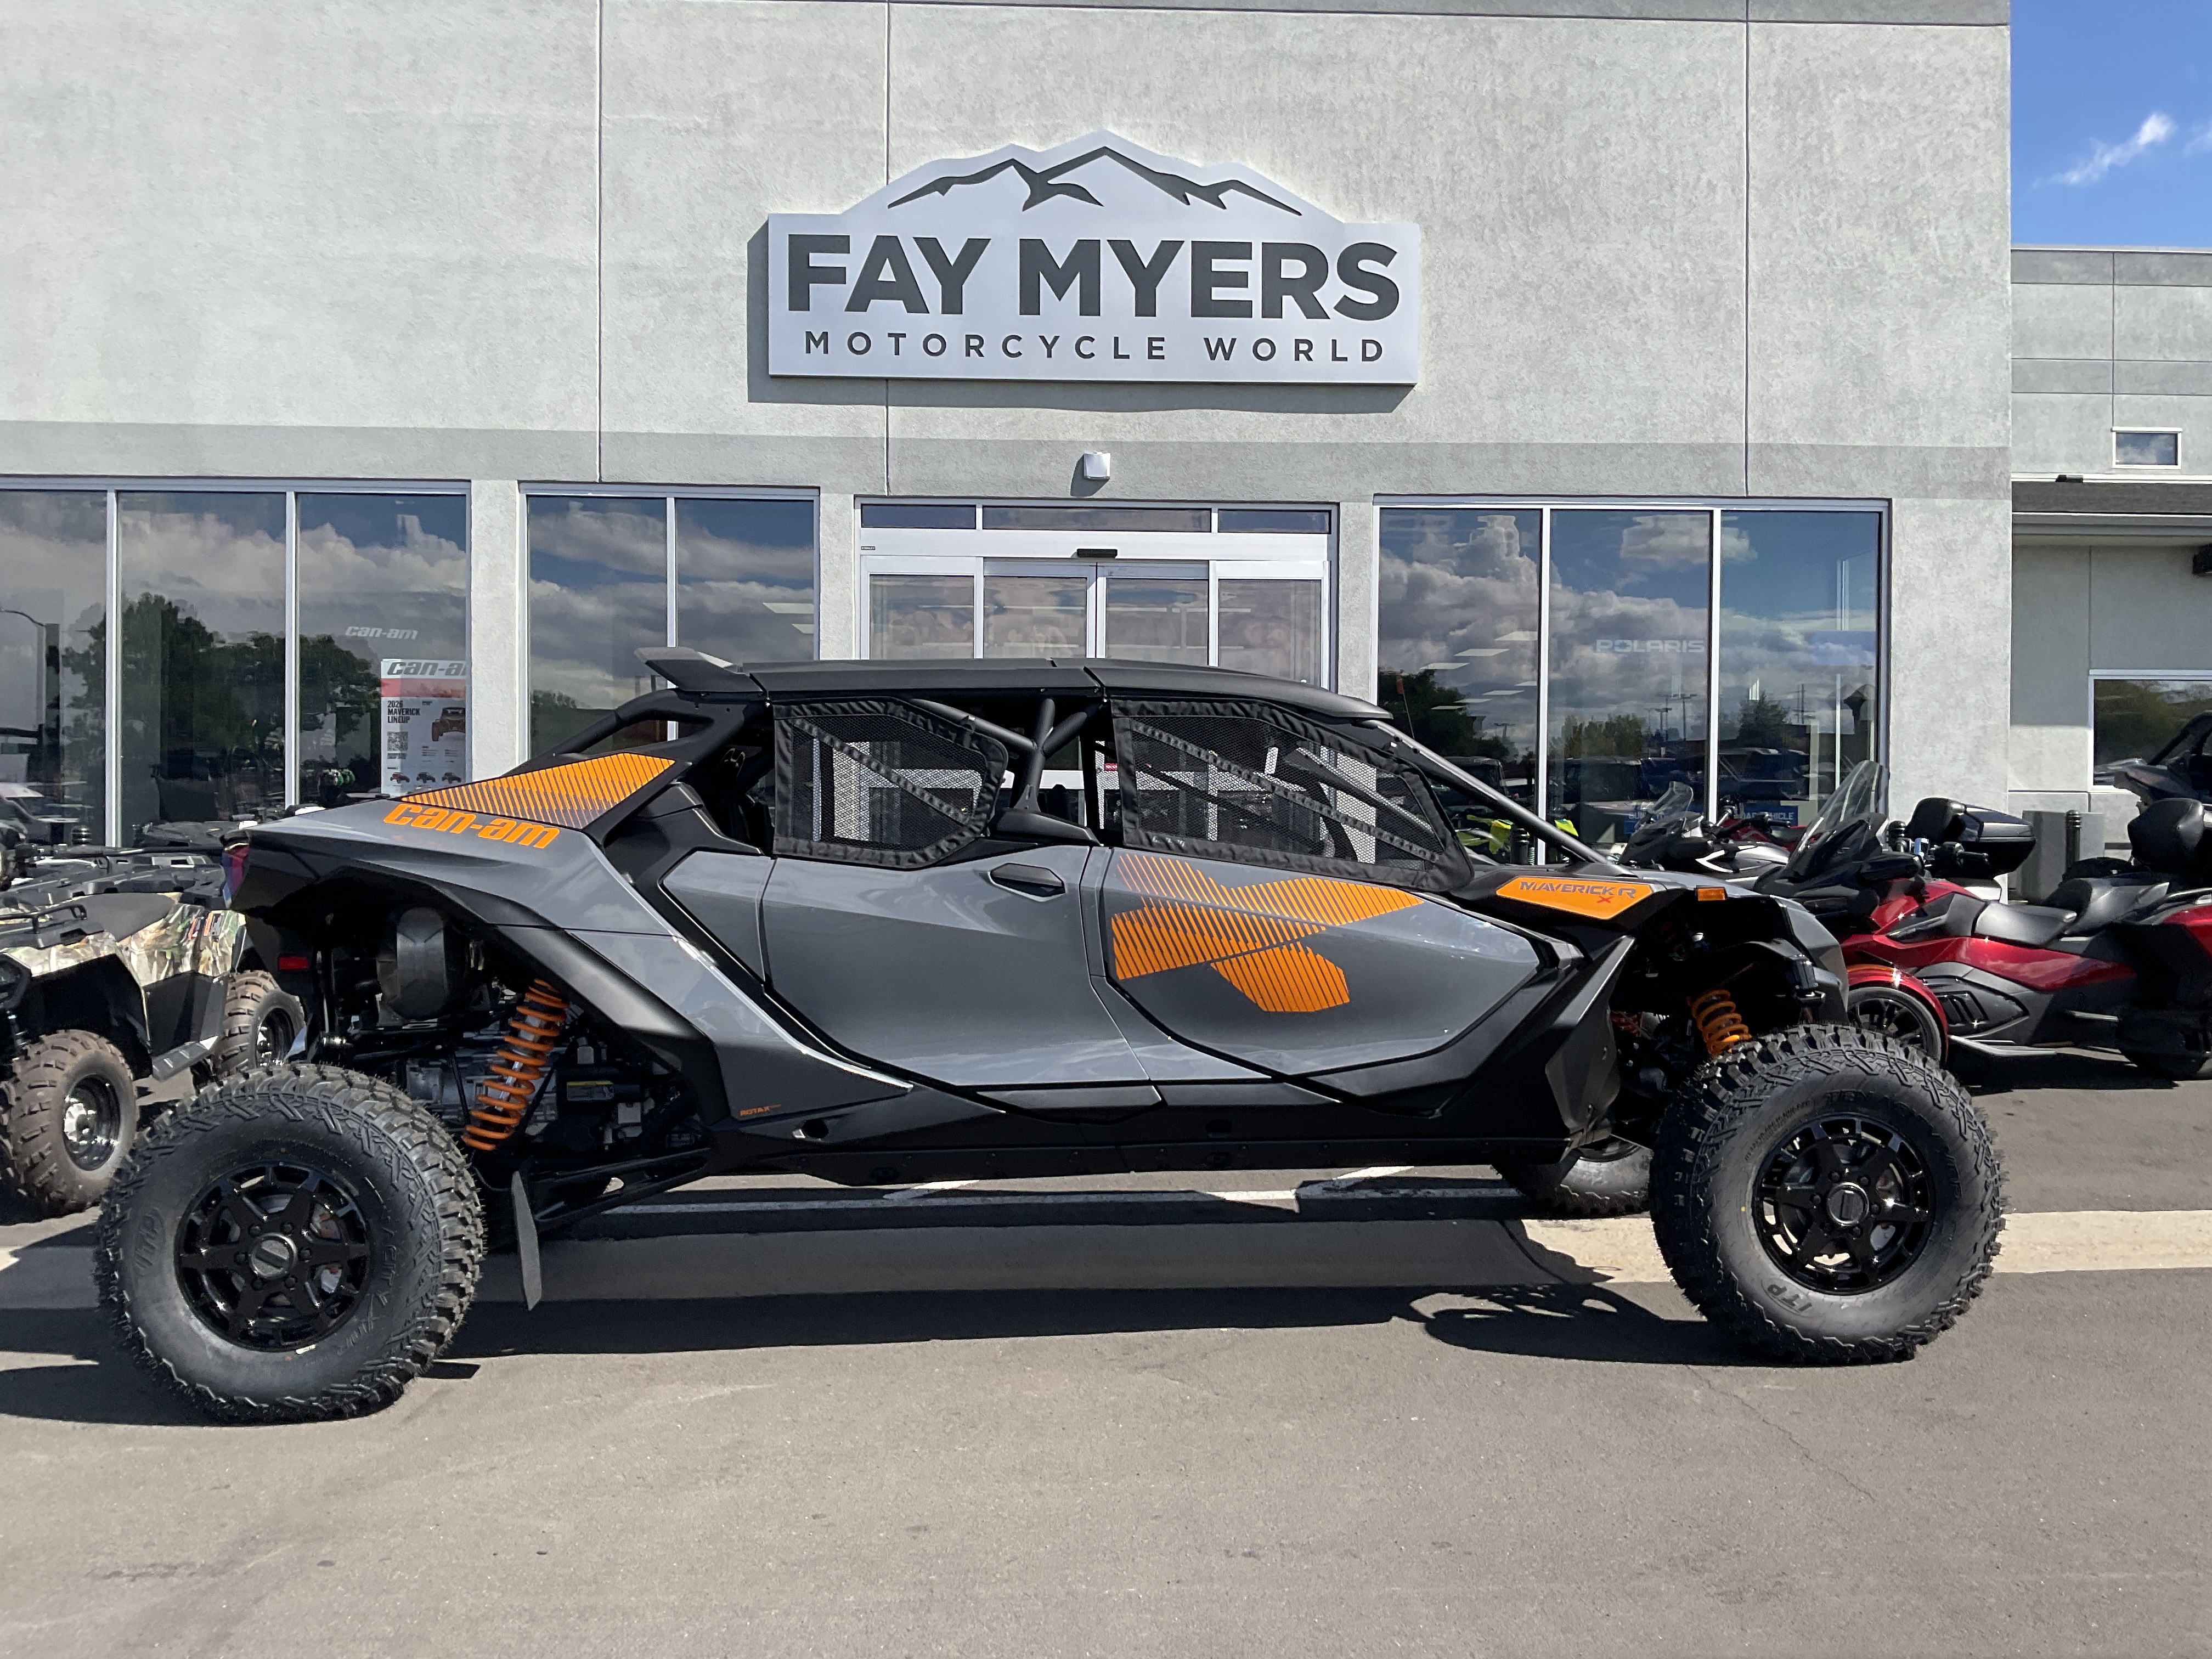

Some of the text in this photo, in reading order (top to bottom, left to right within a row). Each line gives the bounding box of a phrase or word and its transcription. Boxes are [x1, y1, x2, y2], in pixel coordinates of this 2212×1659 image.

[788, 234, 1400, 321] FAY MYERS
[805, 331, 1383, 362] MOTORCYCLE WORLD
[1596, 639, 1705, 653] POLARIS
[387, 662, 465, 676] can-a
[1519, 881, 1636, 899] MAVERICK R
